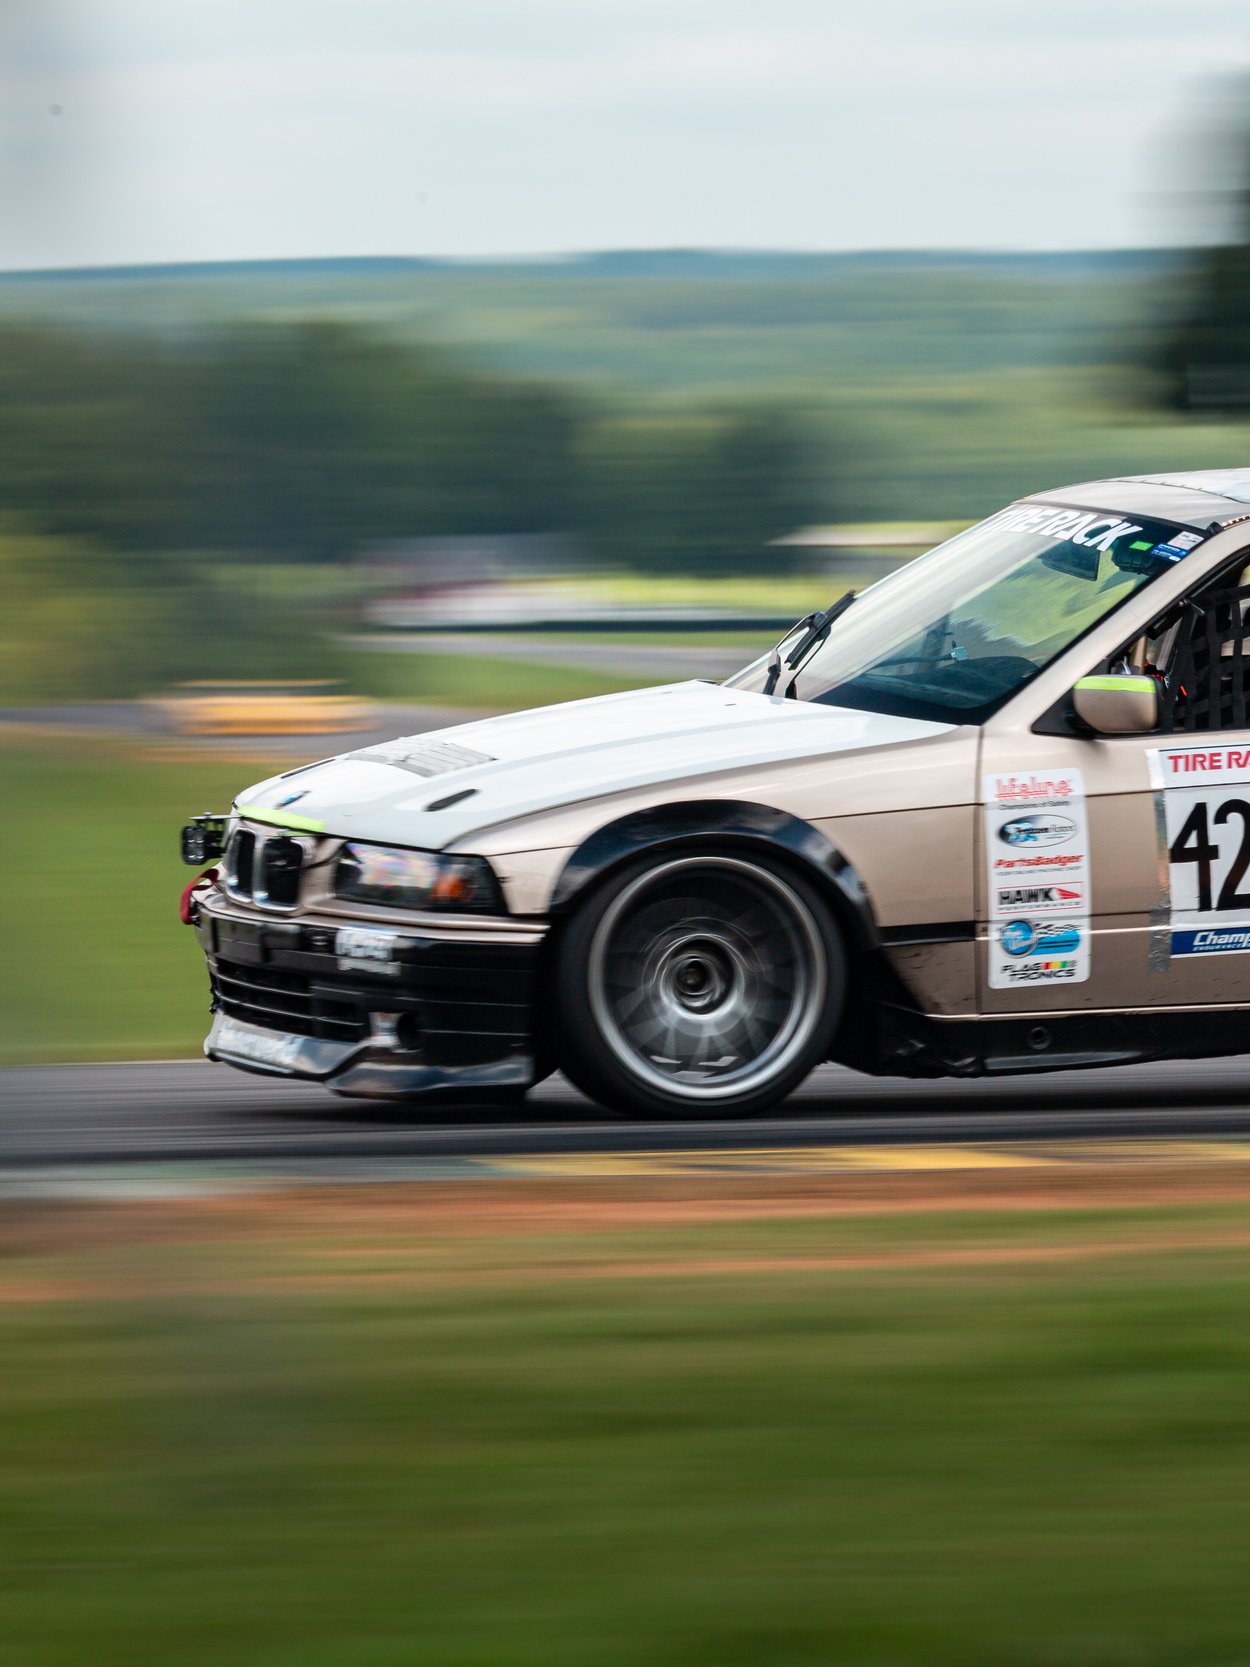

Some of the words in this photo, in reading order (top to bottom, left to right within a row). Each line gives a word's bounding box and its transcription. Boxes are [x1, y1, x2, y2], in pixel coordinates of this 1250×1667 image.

[1168, 752, 1222, 773] TIRE
[999, 887, 1055, 905] HAWK
[1001, 962, 1043, 974] FLAG
[1009, 968, 1077, 981] TRONICS
